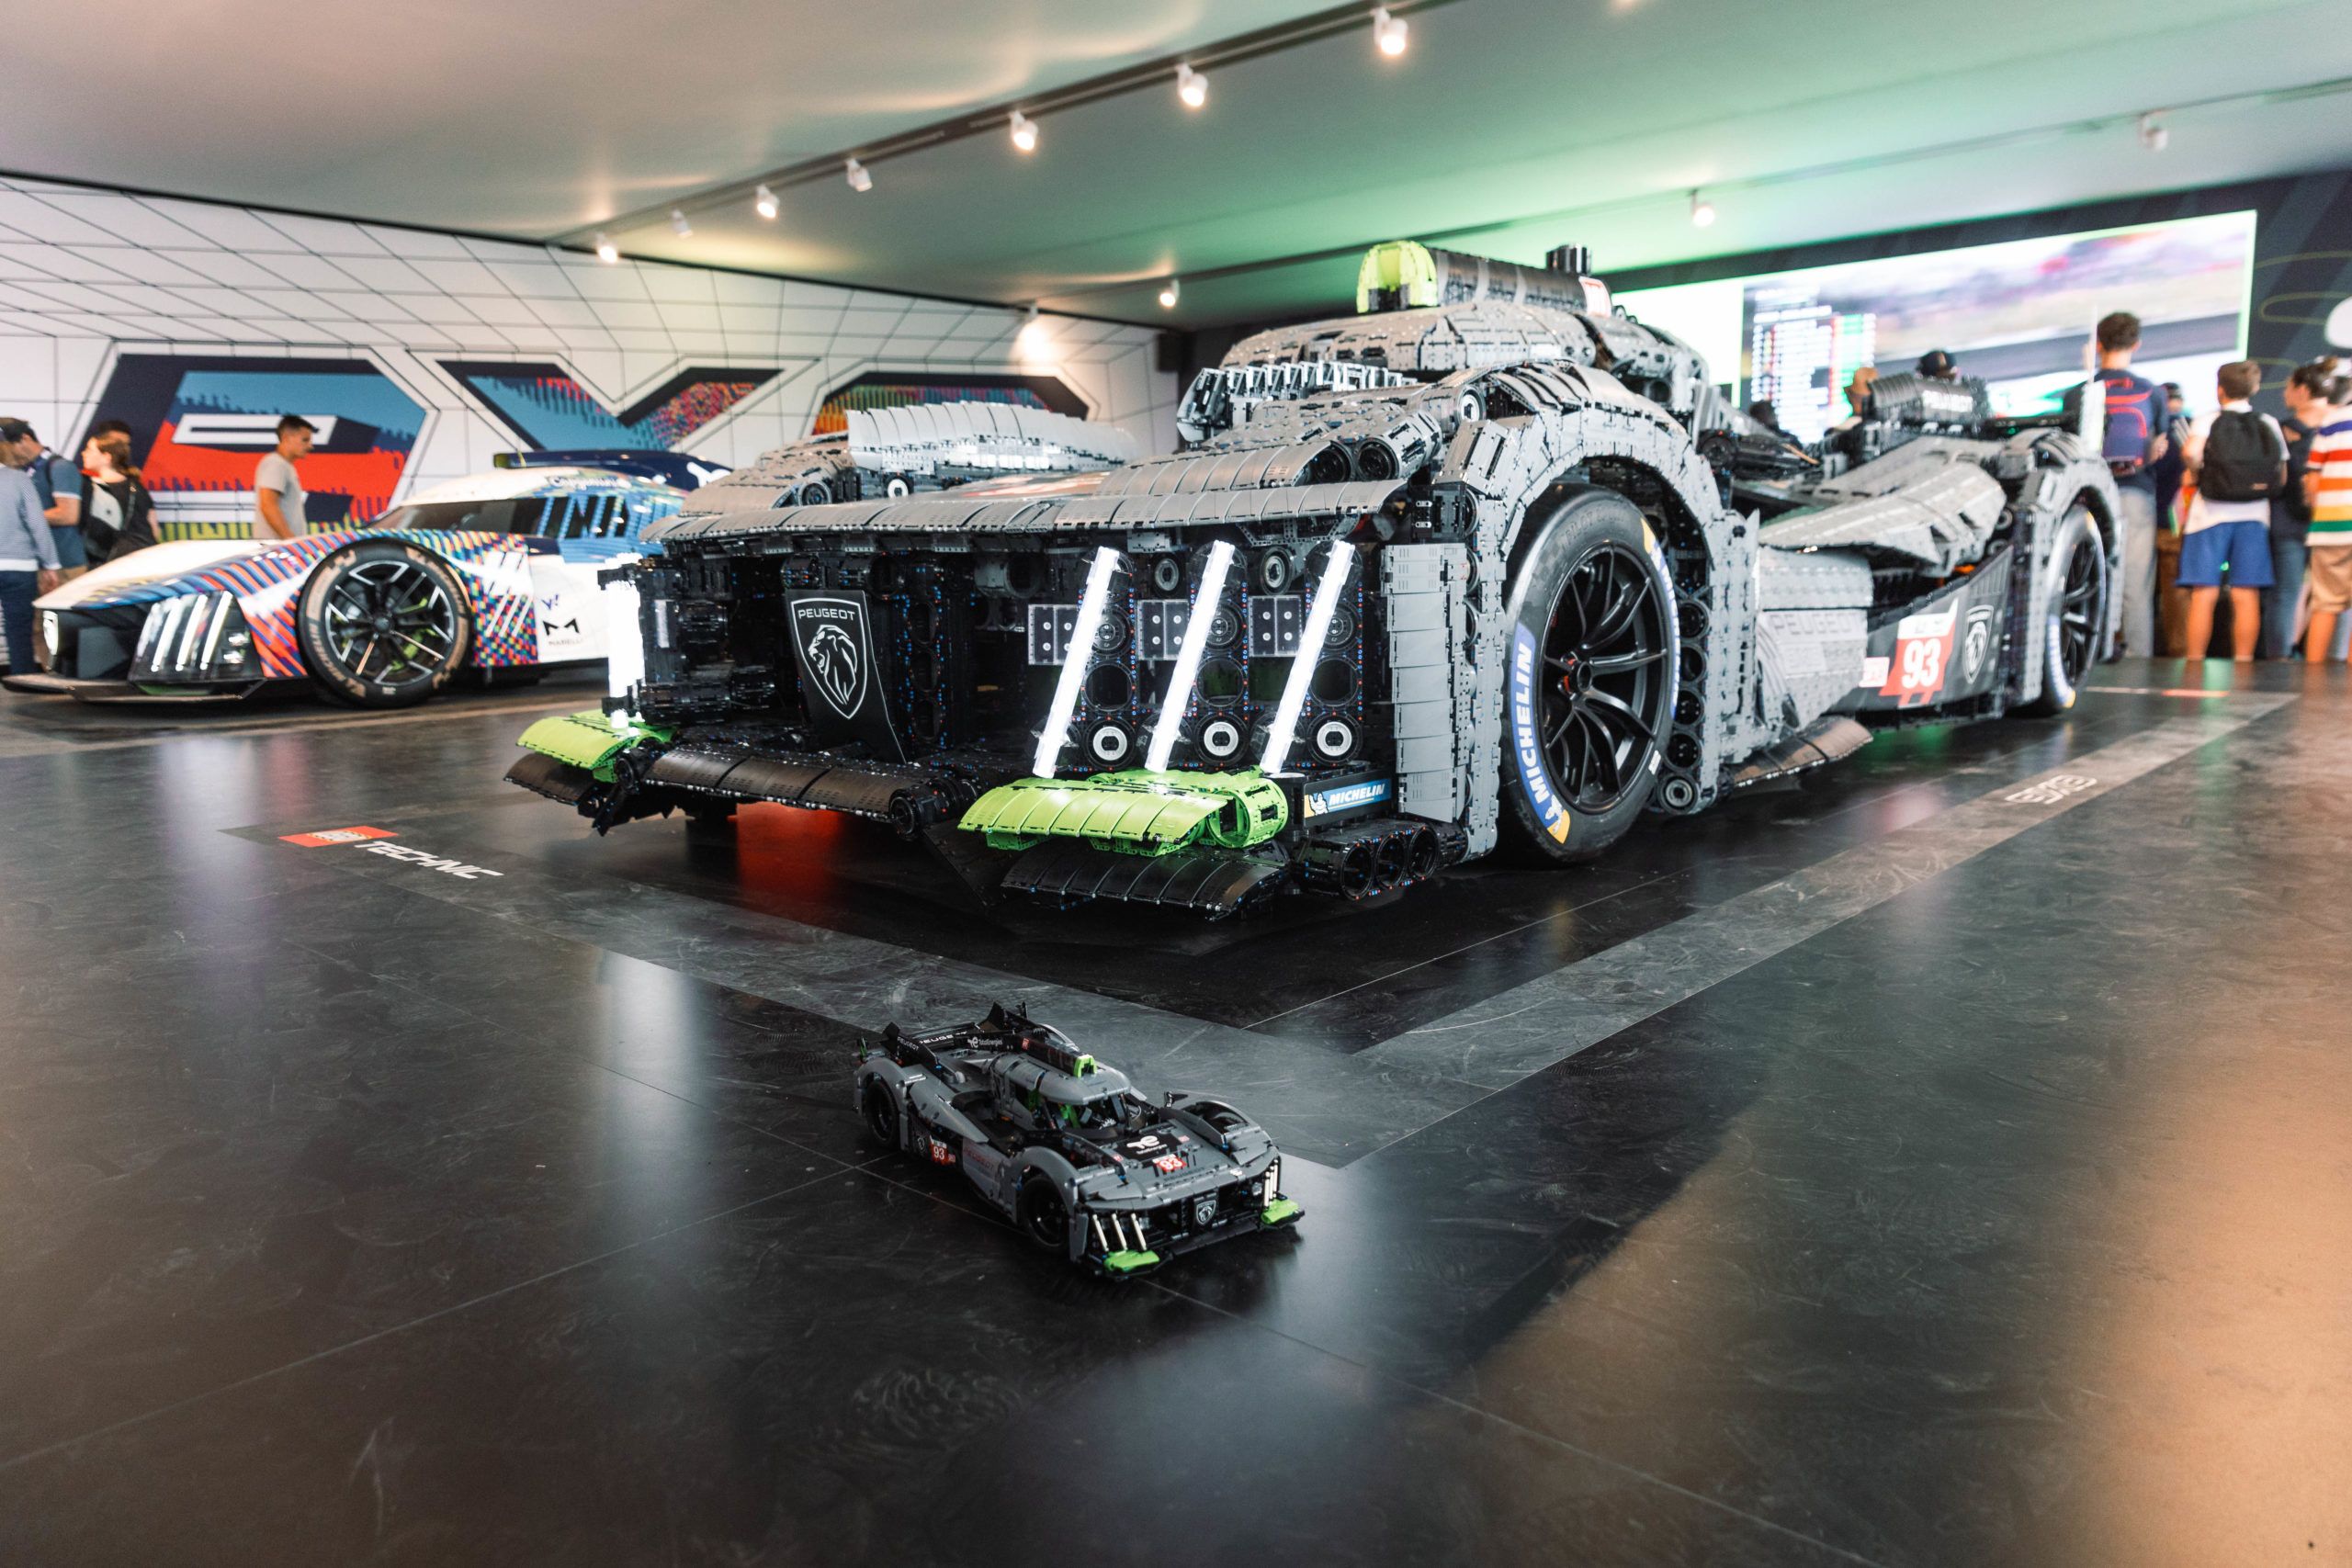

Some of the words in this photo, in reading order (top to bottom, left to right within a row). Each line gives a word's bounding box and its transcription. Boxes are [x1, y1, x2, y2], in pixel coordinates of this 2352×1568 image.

[797, 608, 855, 621] PEUGEOT
[1901, 637, 1941, 689] 93
[1516, 641, 1551, 805] MICHELIN
[1329, 784, 1385, 806] MICHELIN
[355, 840, 504, 879] TECHNIC
[897, 1036, 920, 1052] PEUGEOT
[933, 1145, 945, 1160] 93
